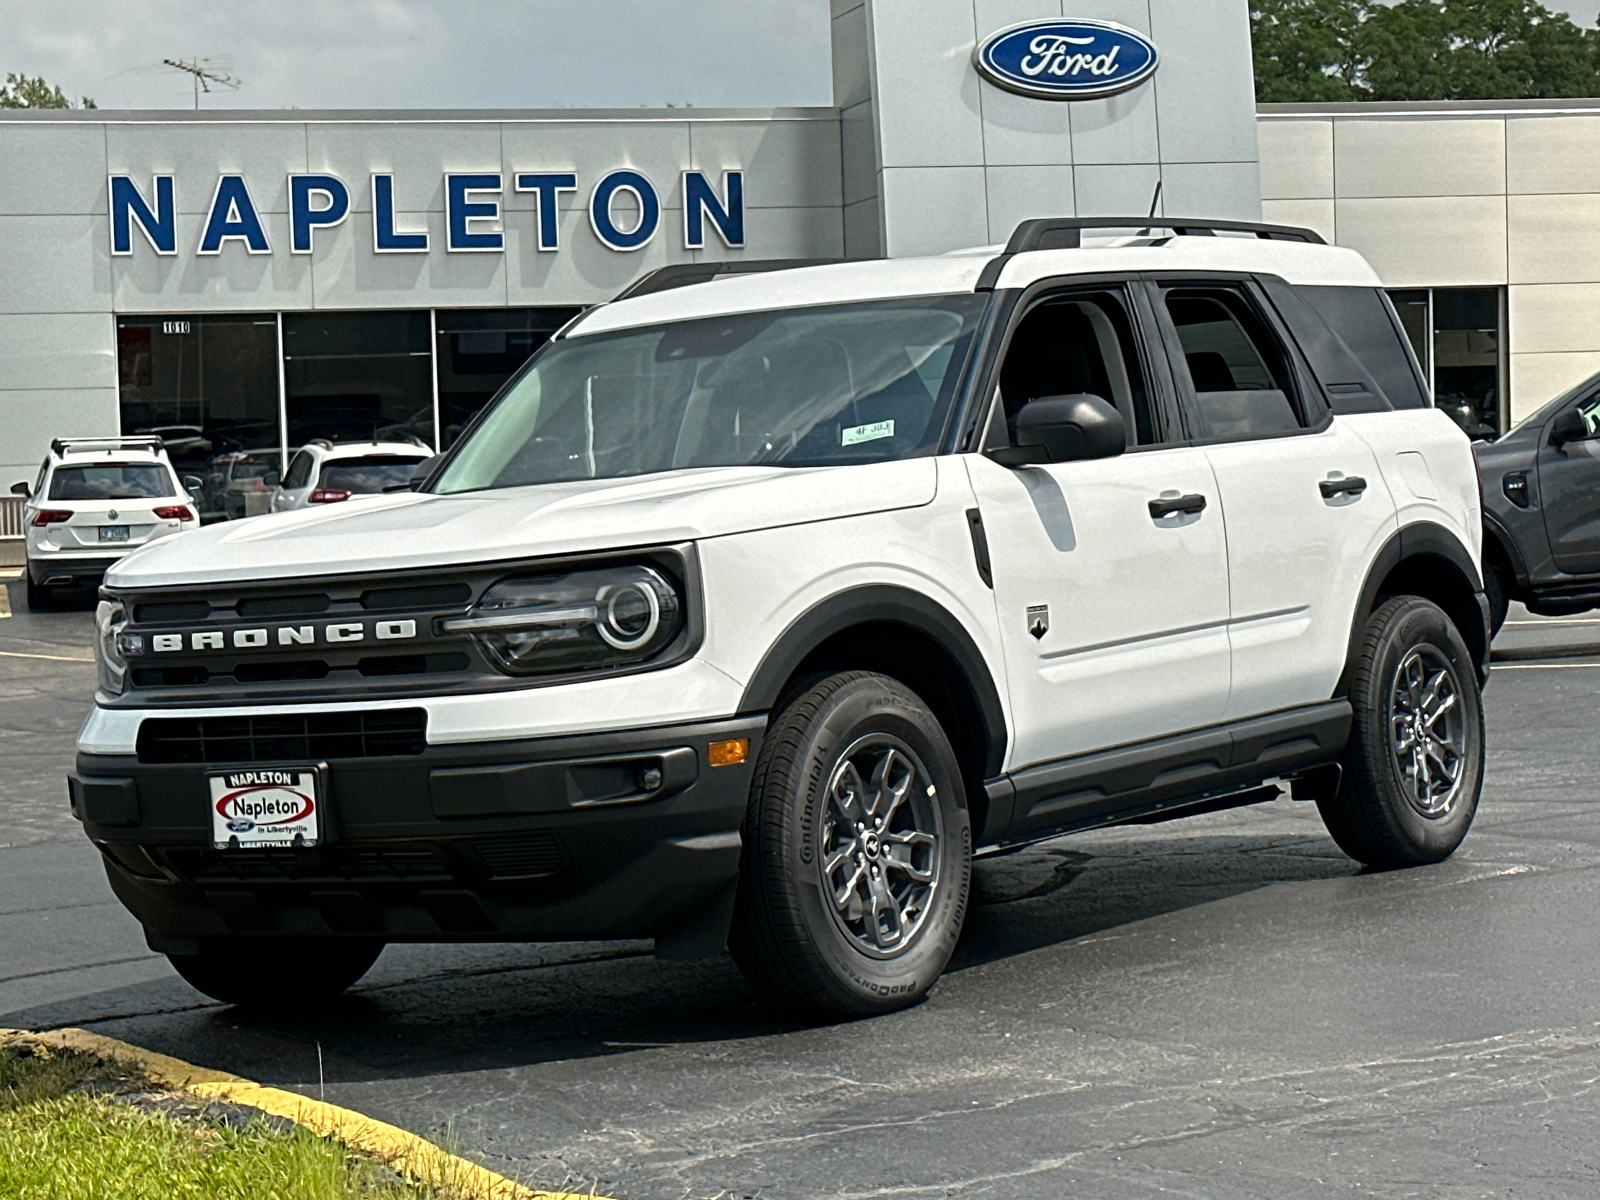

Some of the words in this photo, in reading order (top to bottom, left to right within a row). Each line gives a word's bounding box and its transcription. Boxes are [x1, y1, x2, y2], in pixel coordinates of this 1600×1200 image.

[1020, 34, 1121, 76] Ford
[107, 169, 746, 256] NAPLETON
[165, 322, 190, 334] 1010
[152, 619, 417, 652] BRONCO
[230, 772, 291, 787] NAPLETON
[233, 797, 299, 819] Napleton
[797, 755, 820, 864] Continental
[266, 824, 308, 835] Libertyville
[239, 840, 291, 848] LIBERTYVILLE
